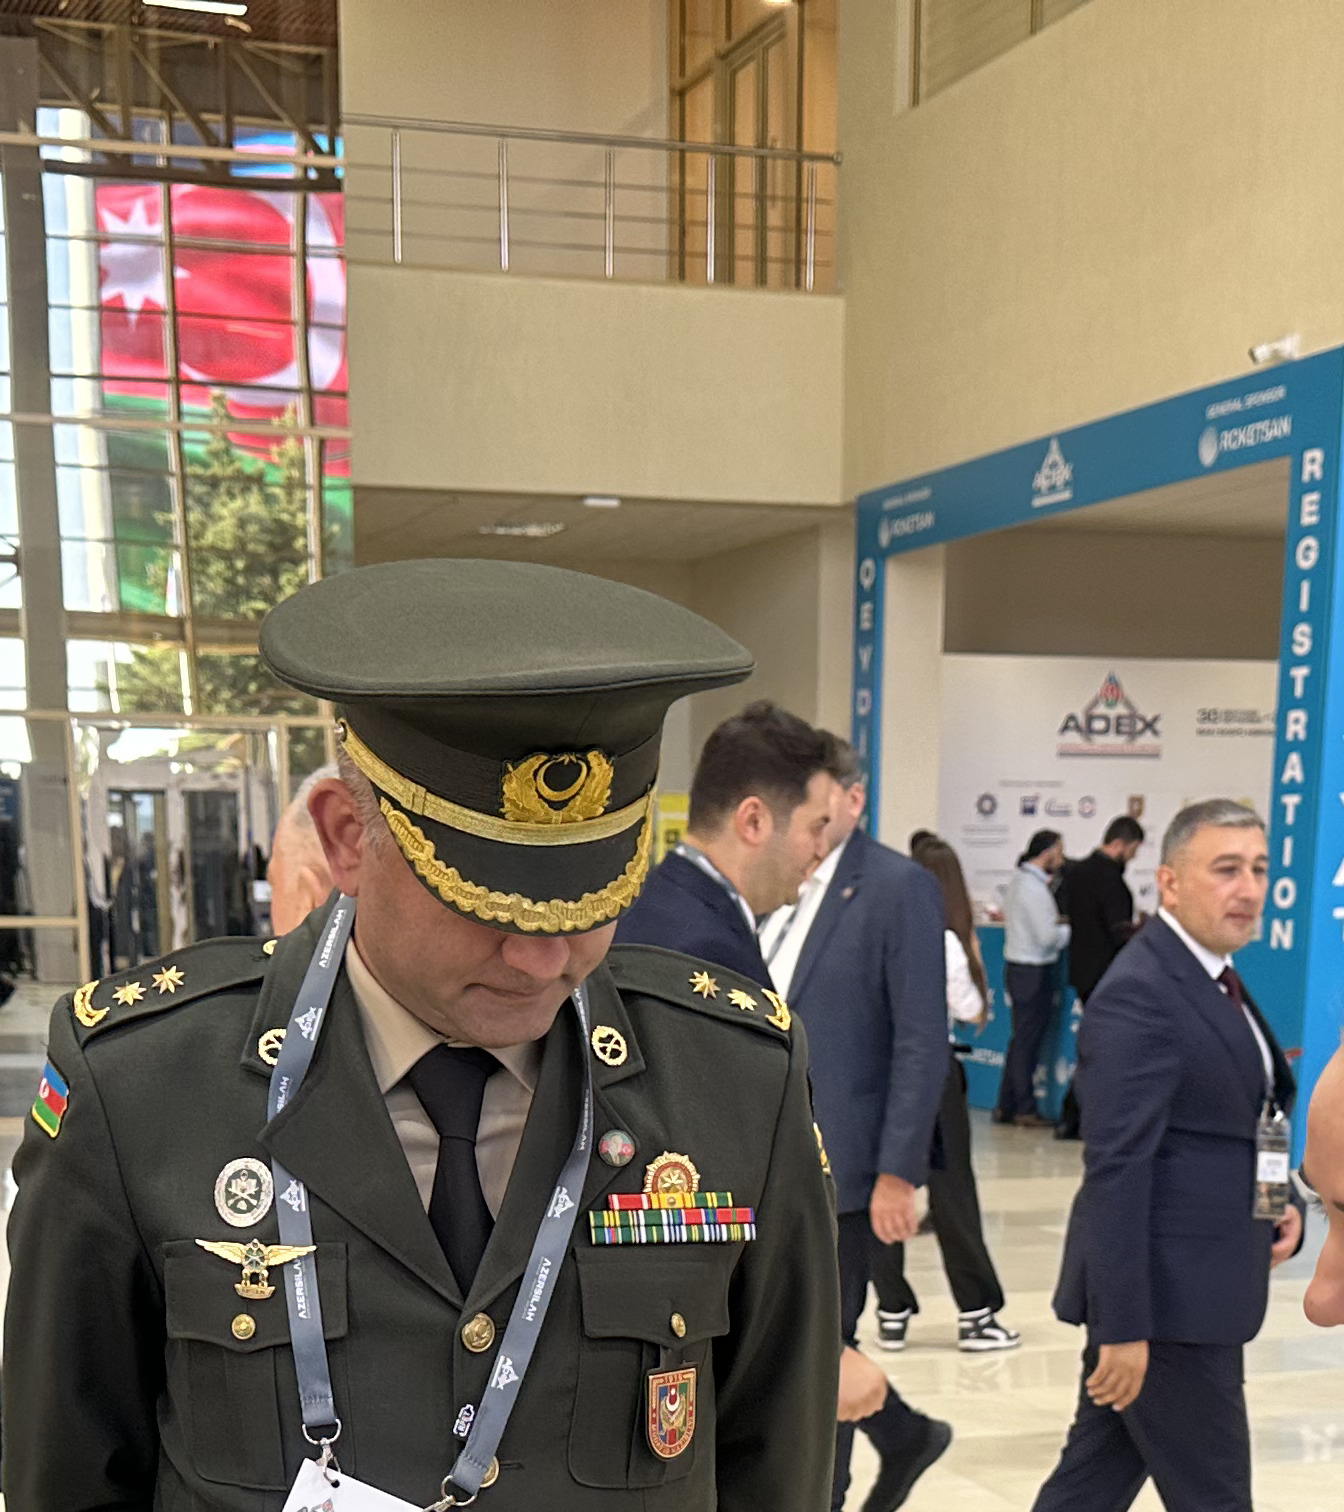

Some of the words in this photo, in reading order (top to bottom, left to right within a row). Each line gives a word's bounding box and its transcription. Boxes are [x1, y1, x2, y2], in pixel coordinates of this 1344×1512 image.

[1220, 414, 1293, 450] ROKETSAN
[1058, 713, 1163, 738] ADEX
[526, 1257, 552, 1321] AZERSILAH
